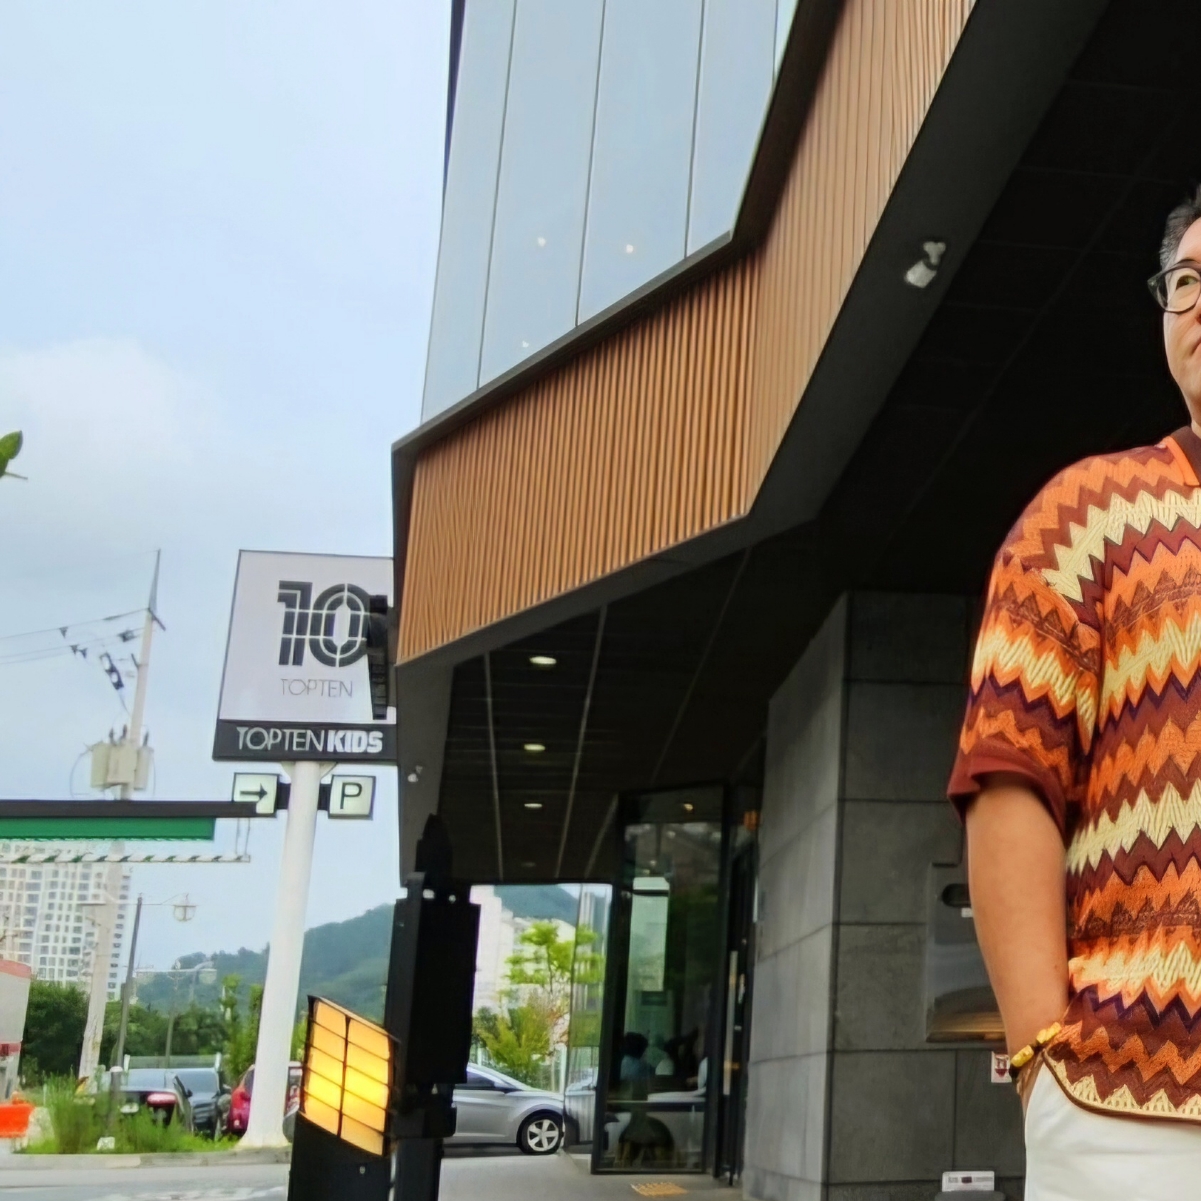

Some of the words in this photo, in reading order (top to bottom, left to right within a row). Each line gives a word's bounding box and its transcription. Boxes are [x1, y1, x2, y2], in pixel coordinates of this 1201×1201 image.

[277, 579, 370, 668] 10
[280, 678, 353, 699] TOPTEN
[340, 781, 363, 810] P
